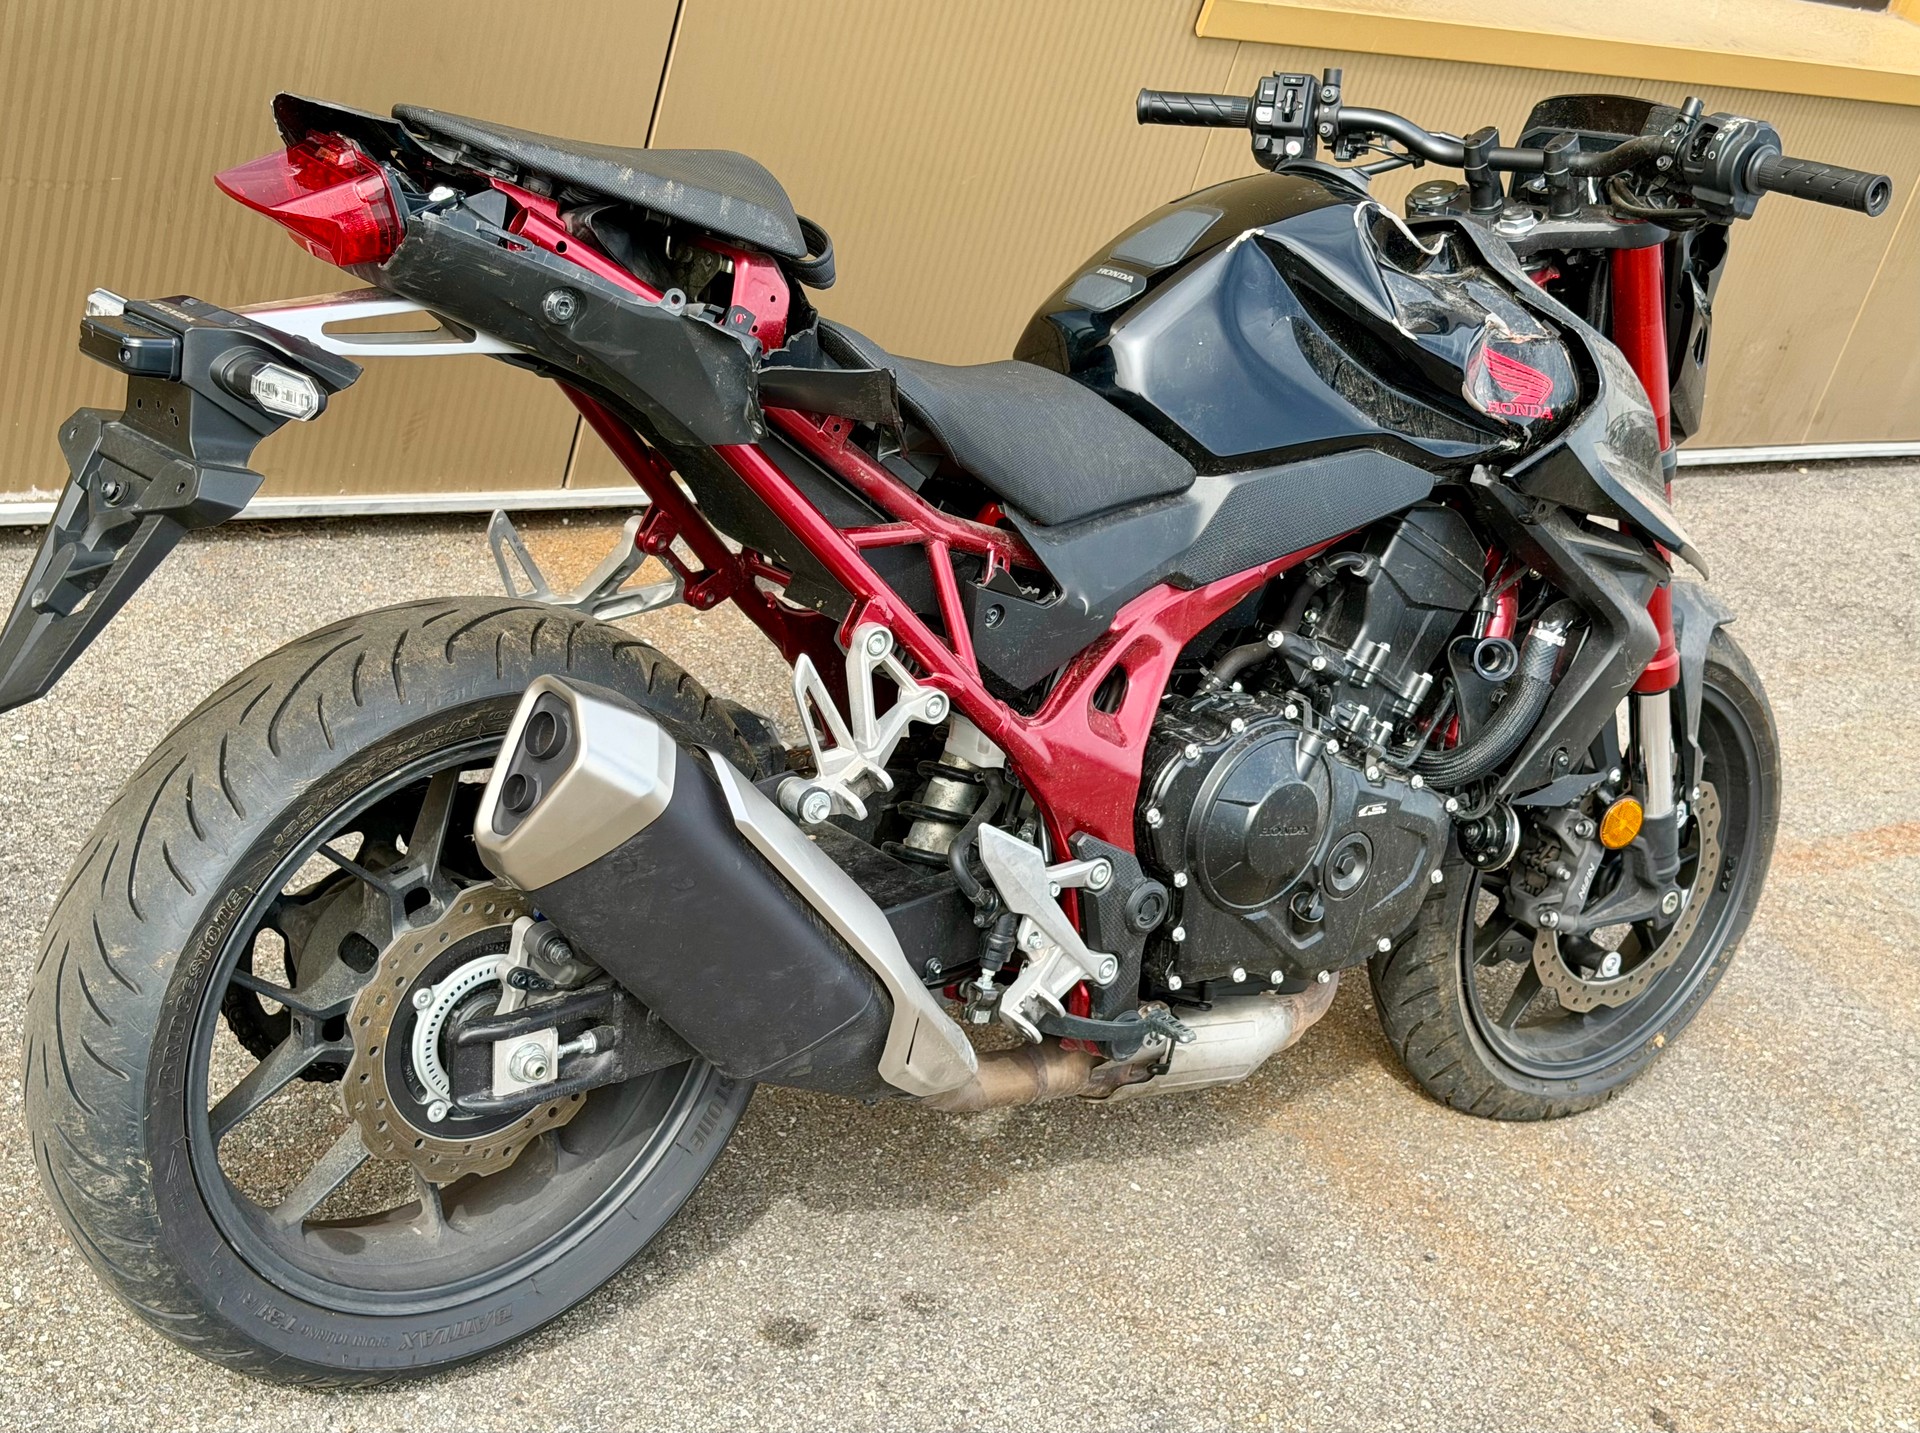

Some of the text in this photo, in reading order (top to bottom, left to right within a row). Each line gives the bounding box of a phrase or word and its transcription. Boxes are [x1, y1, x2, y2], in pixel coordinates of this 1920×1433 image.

[1096, 267, 1134, 283] HONDA
[1486, 400, 1553, 420] HONDA
[1259, 825, 1310, 837] HONDA
[158, 888, 243, 1088] BRIDGESTONE
[399, 1303, 513, 1350] BATTLAX
